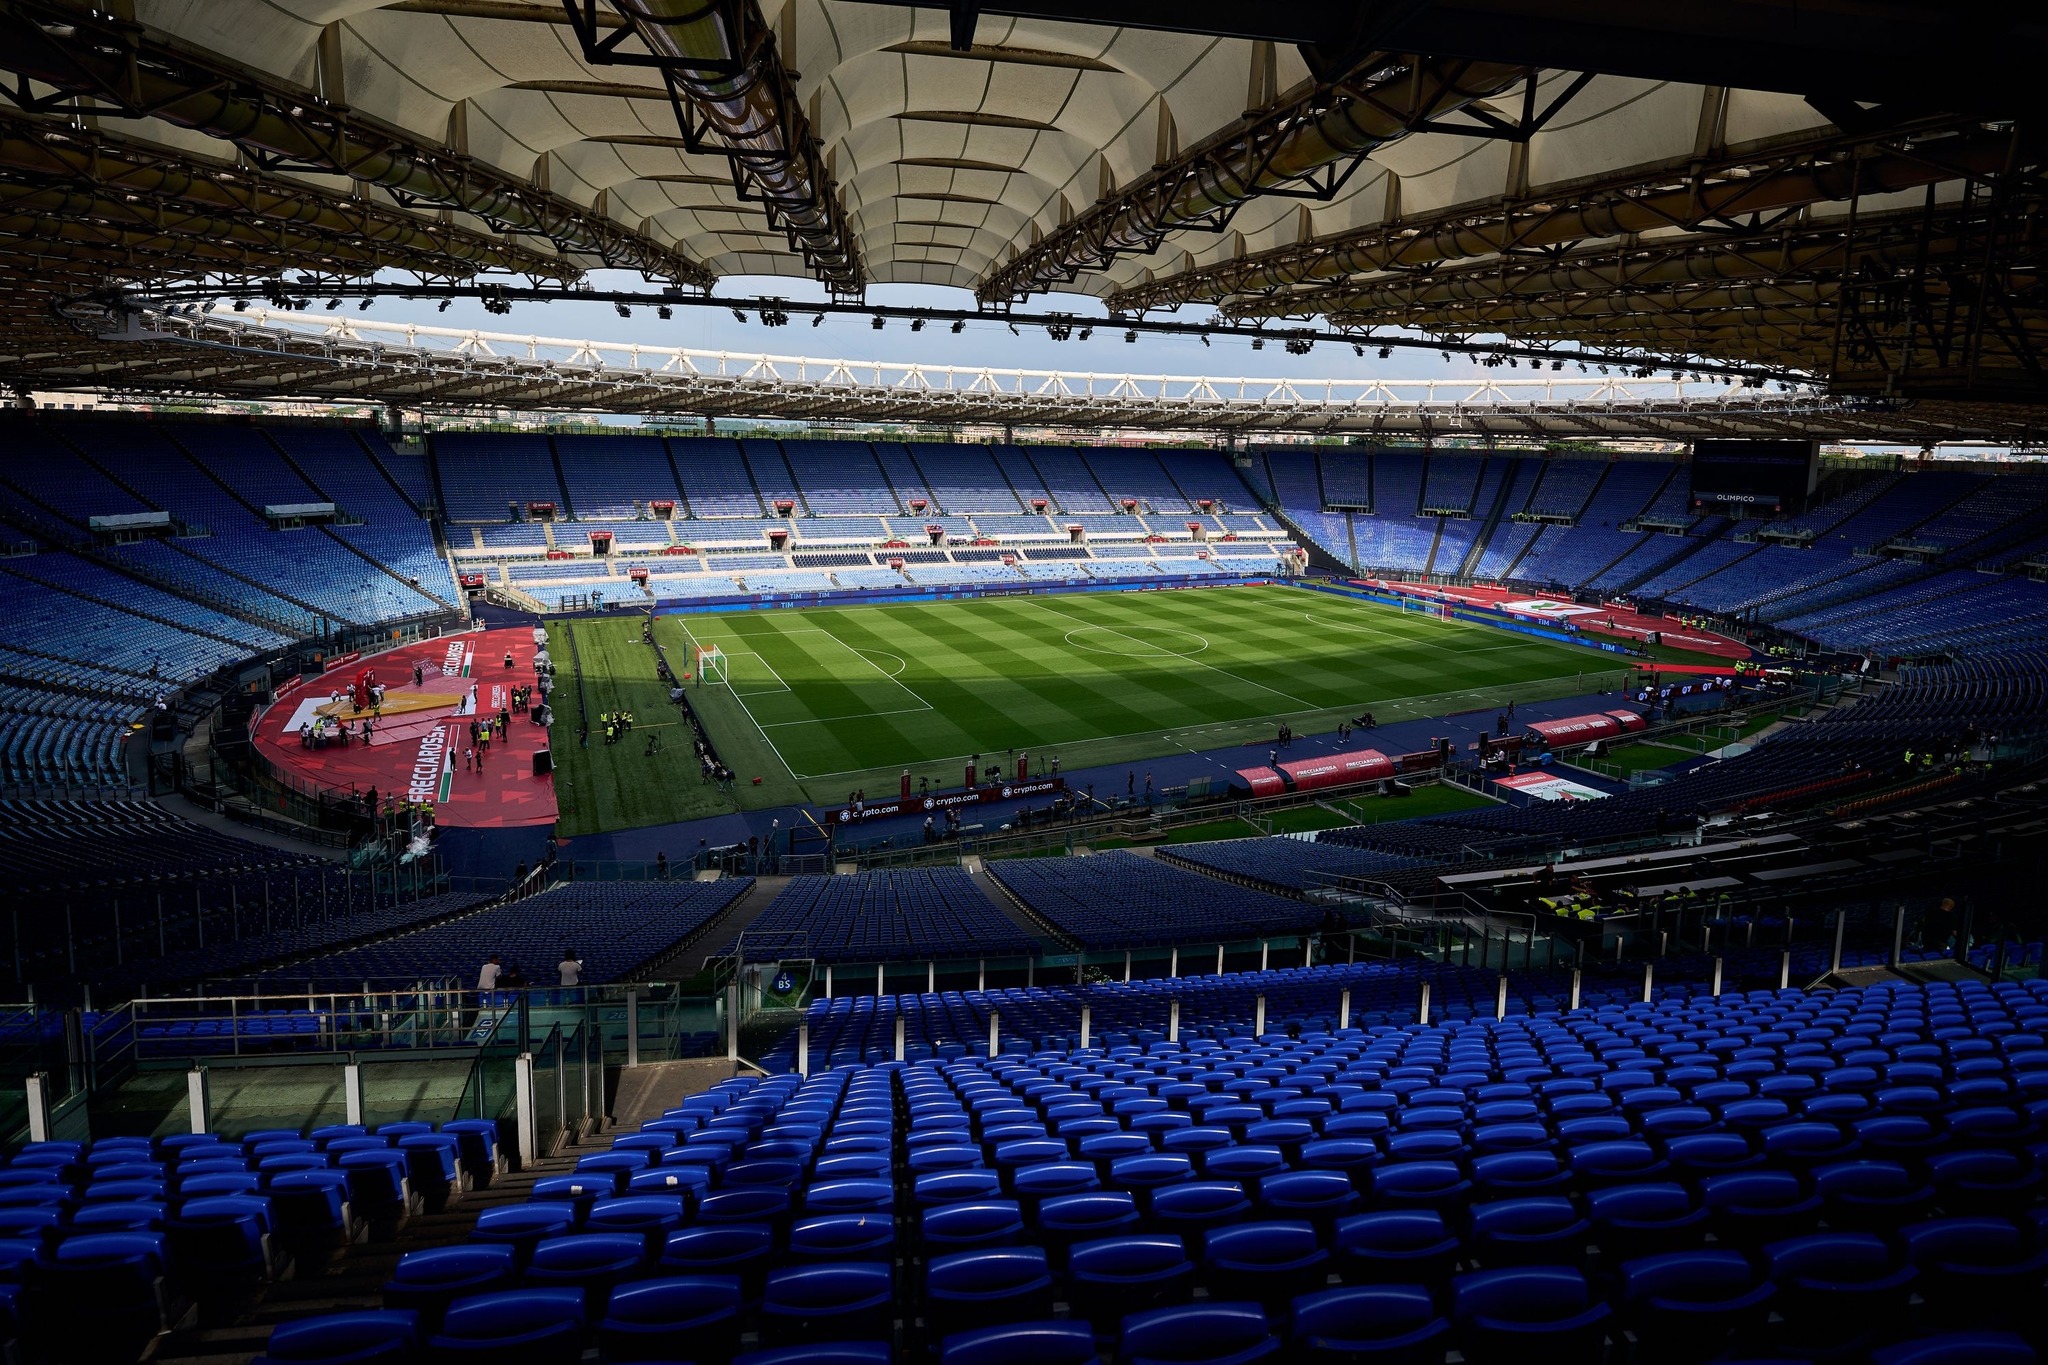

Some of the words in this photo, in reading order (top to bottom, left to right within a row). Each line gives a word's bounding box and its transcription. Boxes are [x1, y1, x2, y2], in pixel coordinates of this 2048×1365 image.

[1717, 494, 1755, 502] OLIMPICO
[1424, 606, 1435, 614] TIM
[1538, 618, 1550, 626] TIM
[1601, 642, 1616, 652] TIM
[442, 641, 465, 676] RECCIAROSSA
[408, 725, 447, 803] FRECCIAROSSA
[1346, 757, 1385, 768] FRECCIAROSSA
[1296, 765, 1338, 776] FRECCIAROSSA
[1013, 781, 1053, 795] crypto.com
[936, 793, 979, 806] crypto.com
[853, 804, 898, 818] cypto.com
[781, 972, 788, 980] 4
[778, 980, 791, 989] BS
